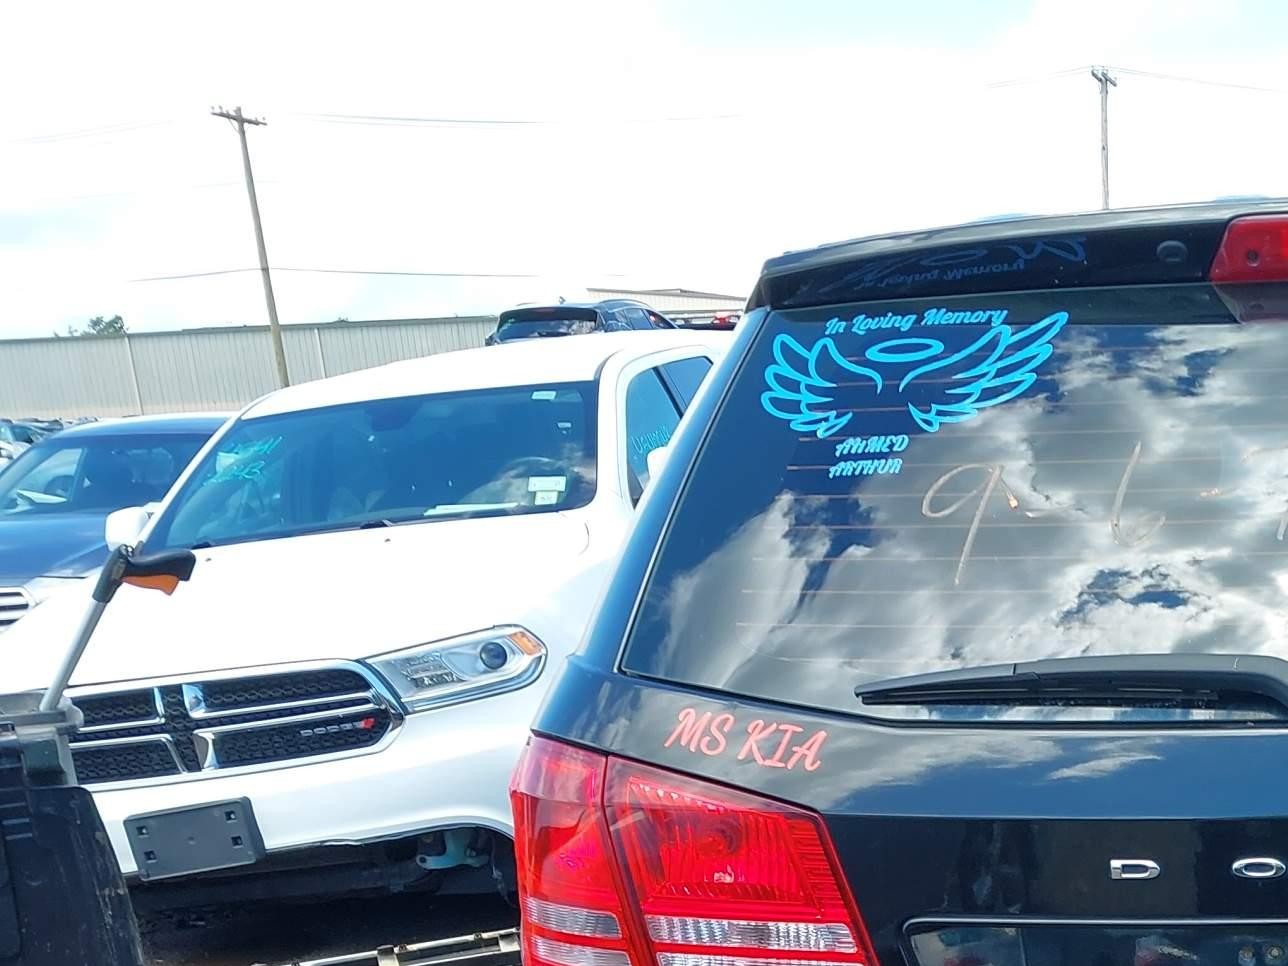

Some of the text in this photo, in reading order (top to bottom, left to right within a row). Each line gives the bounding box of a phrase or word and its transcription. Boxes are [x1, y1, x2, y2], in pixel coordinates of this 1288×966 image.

[825, 308, 1008, 336] In Loving Memory
[835, 434, 909, 457] AHMED
[828, 458, 903, 479] ARTHUR
[664, 707, 828, 771] MS KIA
